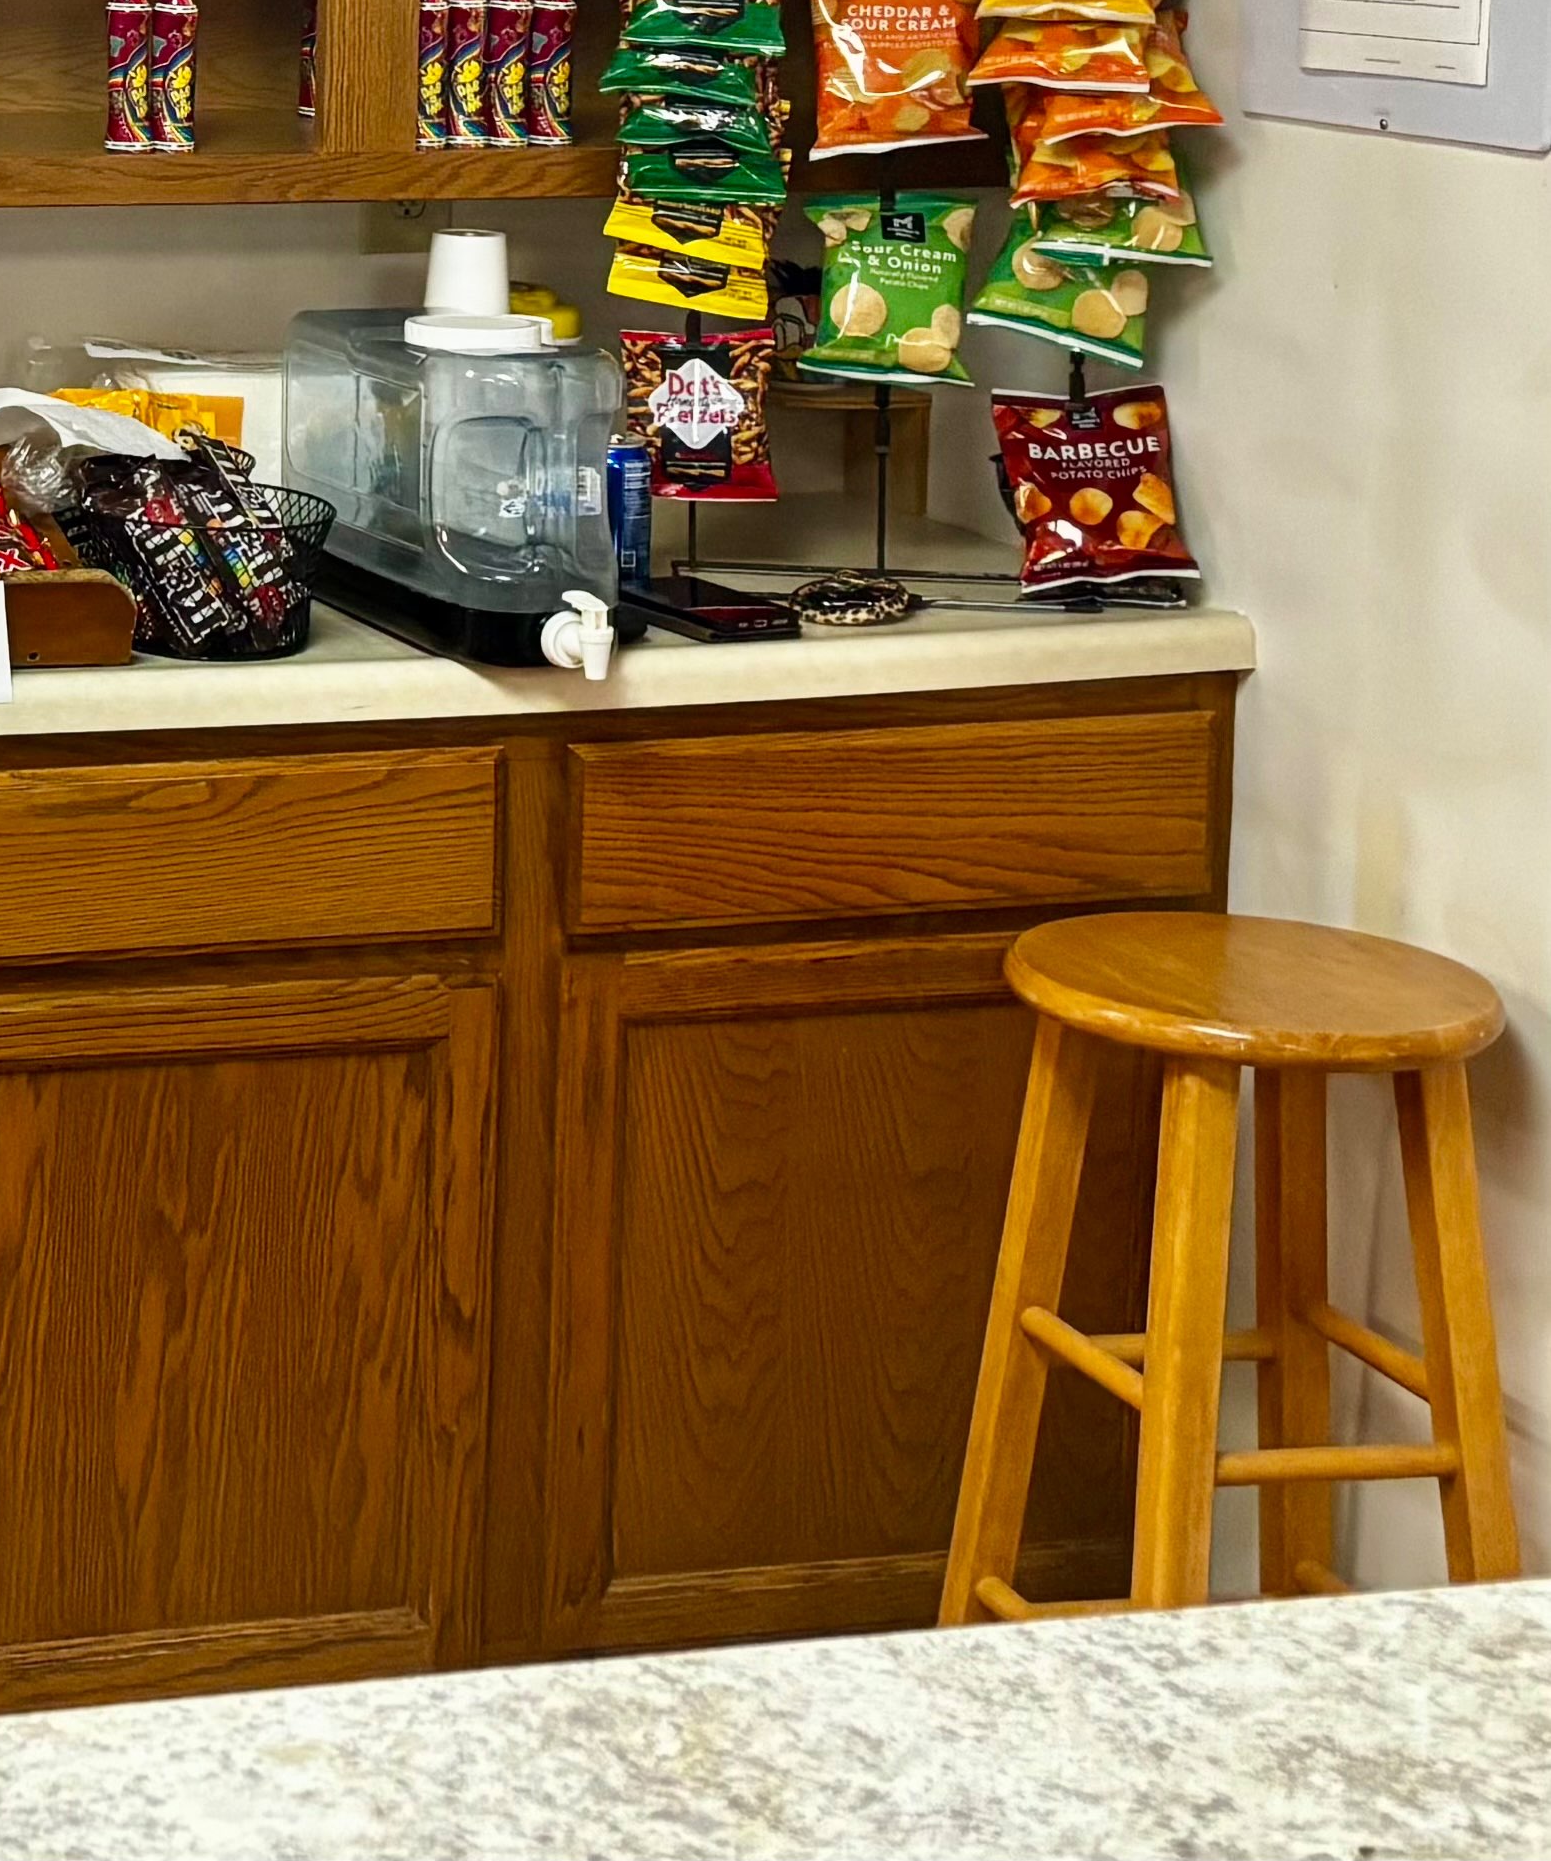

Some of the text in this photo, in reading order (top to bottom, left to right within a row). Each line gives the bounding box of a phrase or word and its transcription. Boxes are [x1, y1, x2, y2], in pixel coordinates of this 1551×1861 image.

[848, 4, 950, 18] CHEDDAR &
[841, 16, 957, 32] SOUR CREAM
[851, 240, 957, 263] Sour Cream
[867, 255, 942, 275] & Onion
[1028, 436, 1161, 461] BARBECUE
[1062, 457, 1131, 469] FLAVORED
[1051, 465, 1148, 480] POTATO CHIPS
